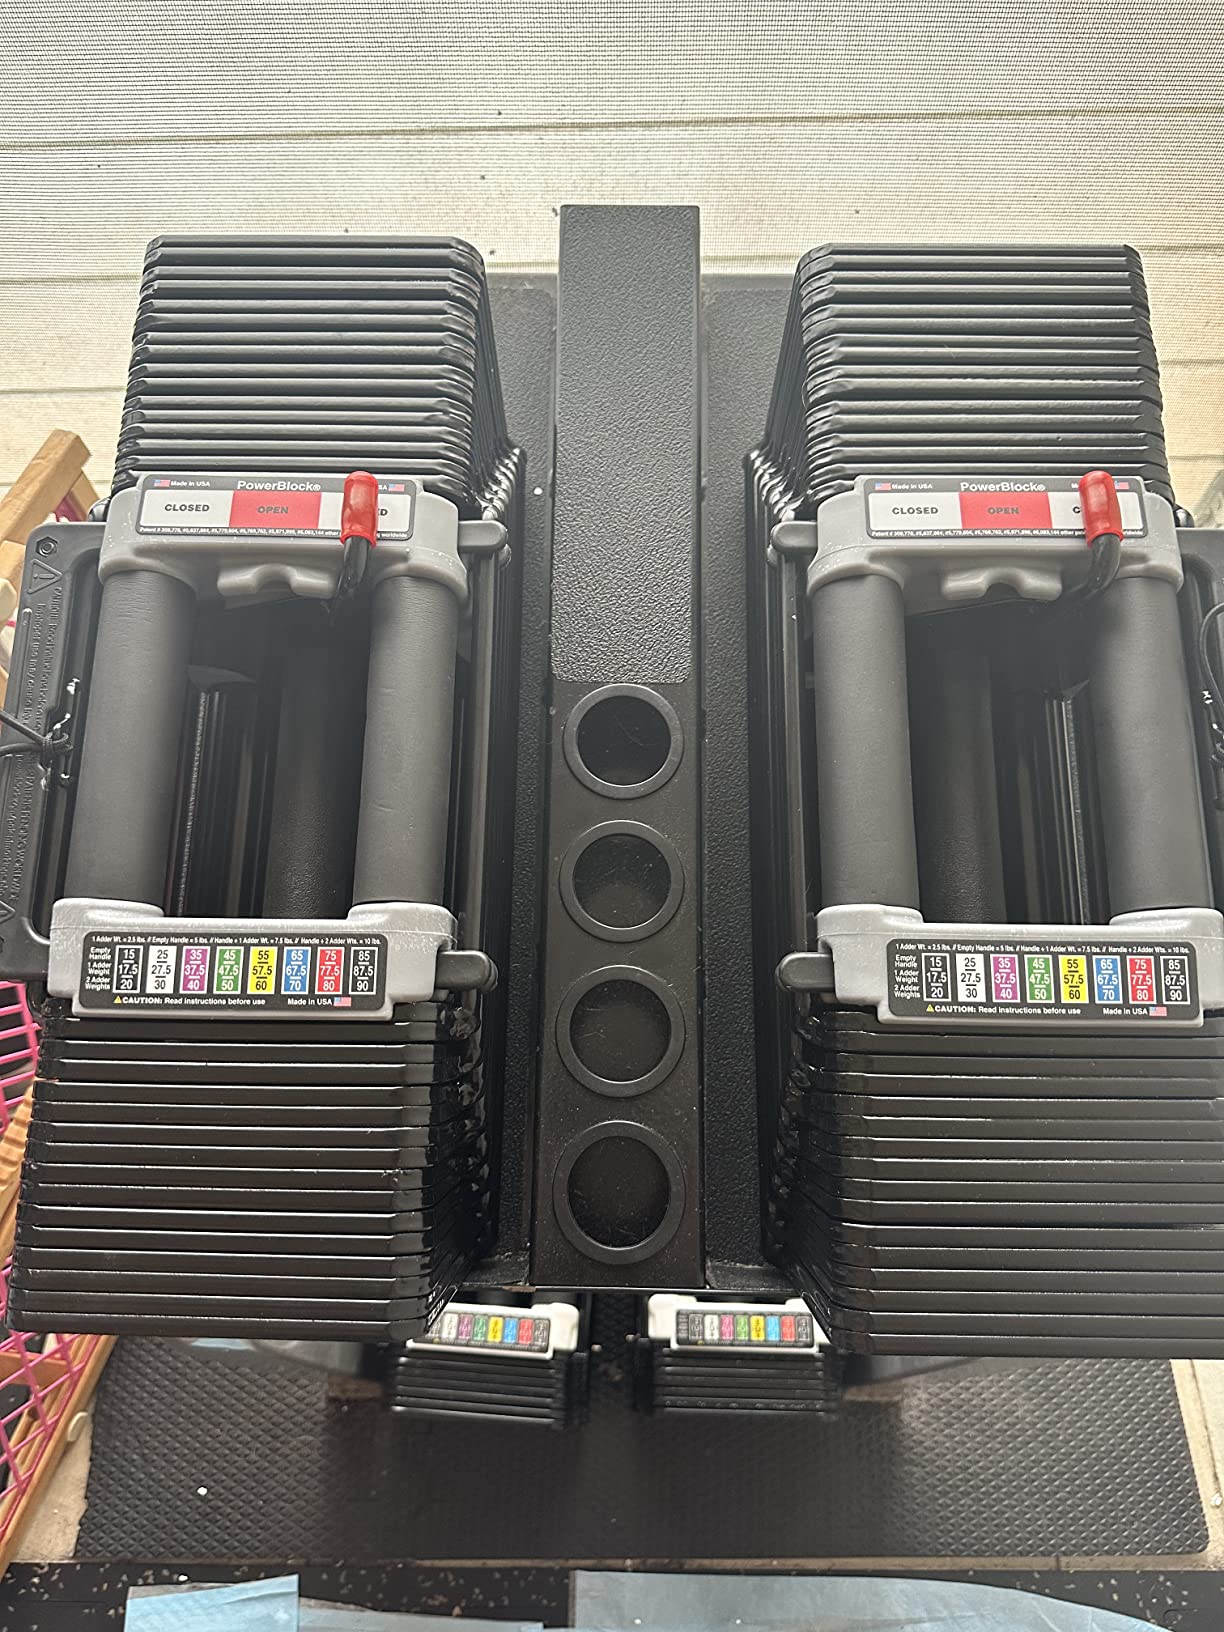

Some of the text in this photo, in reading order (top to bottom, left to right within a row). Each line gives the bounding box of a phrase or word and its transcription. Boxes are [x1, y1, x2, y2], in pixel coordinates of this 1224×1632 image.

[164, 503, 210, 512] CLOSED
[257, 506, 289, 514] OPEN
[891, 506, 939, 515] CLOSED
[987, 506, 1019, 515] OPEN
[90, 946, 111, 954] Empty
[957, 944, 975, 952] Empty
[124, 949, 135, 959] 15
[157, 949, 168, 960] 25
[190, 949, 202, 960] 35
[223, 950, 235, 960] 45
[258, 950, 269, 960] 55
[291, 950, 303, 961] 65
[325, 951, 337, 961] 75
[358, 951, 370, 961] 85
[895, 954, 917, 962] Empty
[930, 957, 941, 967] 15
[964, 957, 976, 967] 25
[998, 958, 1010, 968] 35
[1032, 958, 1045, 968] 45
[1067, 959, 1078, 969] 55
[1100, 959, 1113, 970] 65
[1134, 960, 1147, 970] 75
[1168, 960, 1180, 970] 85
[88, 968, 110, 976] Weight
[119, 964, 138, 975] 17.5
[151, 965, 171, 975] 27.5
[184, 965, 205, 975] 37.5
[218, 965, 239, 976] 47.5
[252, 966, 273, 976] 57.5
[286, 966, 306, 976] 67.5
[320, 966, 340, 976] 77.5
[353, 966, 374, 976] 87.5
[895, 976, 918, 984] Weight
[926, 972, 947, 982] 17.5
[961, 973, 981, 983] 27.5
[994, 973, 1016, 984] 37.5
[1029, 974, 1050, 984] 47.5
[1063, 974, 1084, 984] 57.5
[1097, 975, 1118, 985] 67.5
[1131, 975, 1152, 985] 77.5
[1165, 975, 1186, 985] 87.5
[85, 982, 111, 991] Weights
[121, 979, 133, 989] 20
[154, 980, 166, 990] 30
[187, 980, 199, 990] 40
[221, 980, 234, 990] 50
[255, 981, 267, 991] 60
[289, 981, 301, 991] 70
[323, 981, 335, 991] 80
[356, 981, 368, 991] 90
[894, 991, 921, 999] Weights
[931, 987, 943, 998] 20
[965, 988, 977, 998] 30
[1000, 988, 1012, 999] 40
[1034, 989, 1047, 999] 50
[1068, 990, 1080, 1000] 60
[1102, 990, 1115, 1000] 70
[1136, 990, 1148, 1000] 80
[1169, 990, 1182, 1001] 90
[122, 996, 163, 1004] CAUTION:
[184, 997, 226, 1005] instructions
[316, 998, 332, 1006] USA
[934, 1005, 976, 1013] CAUTION:
[998, 1006, 1041, 1014] instructions
[1102, 1007, 1148, 1015] Made in USA
